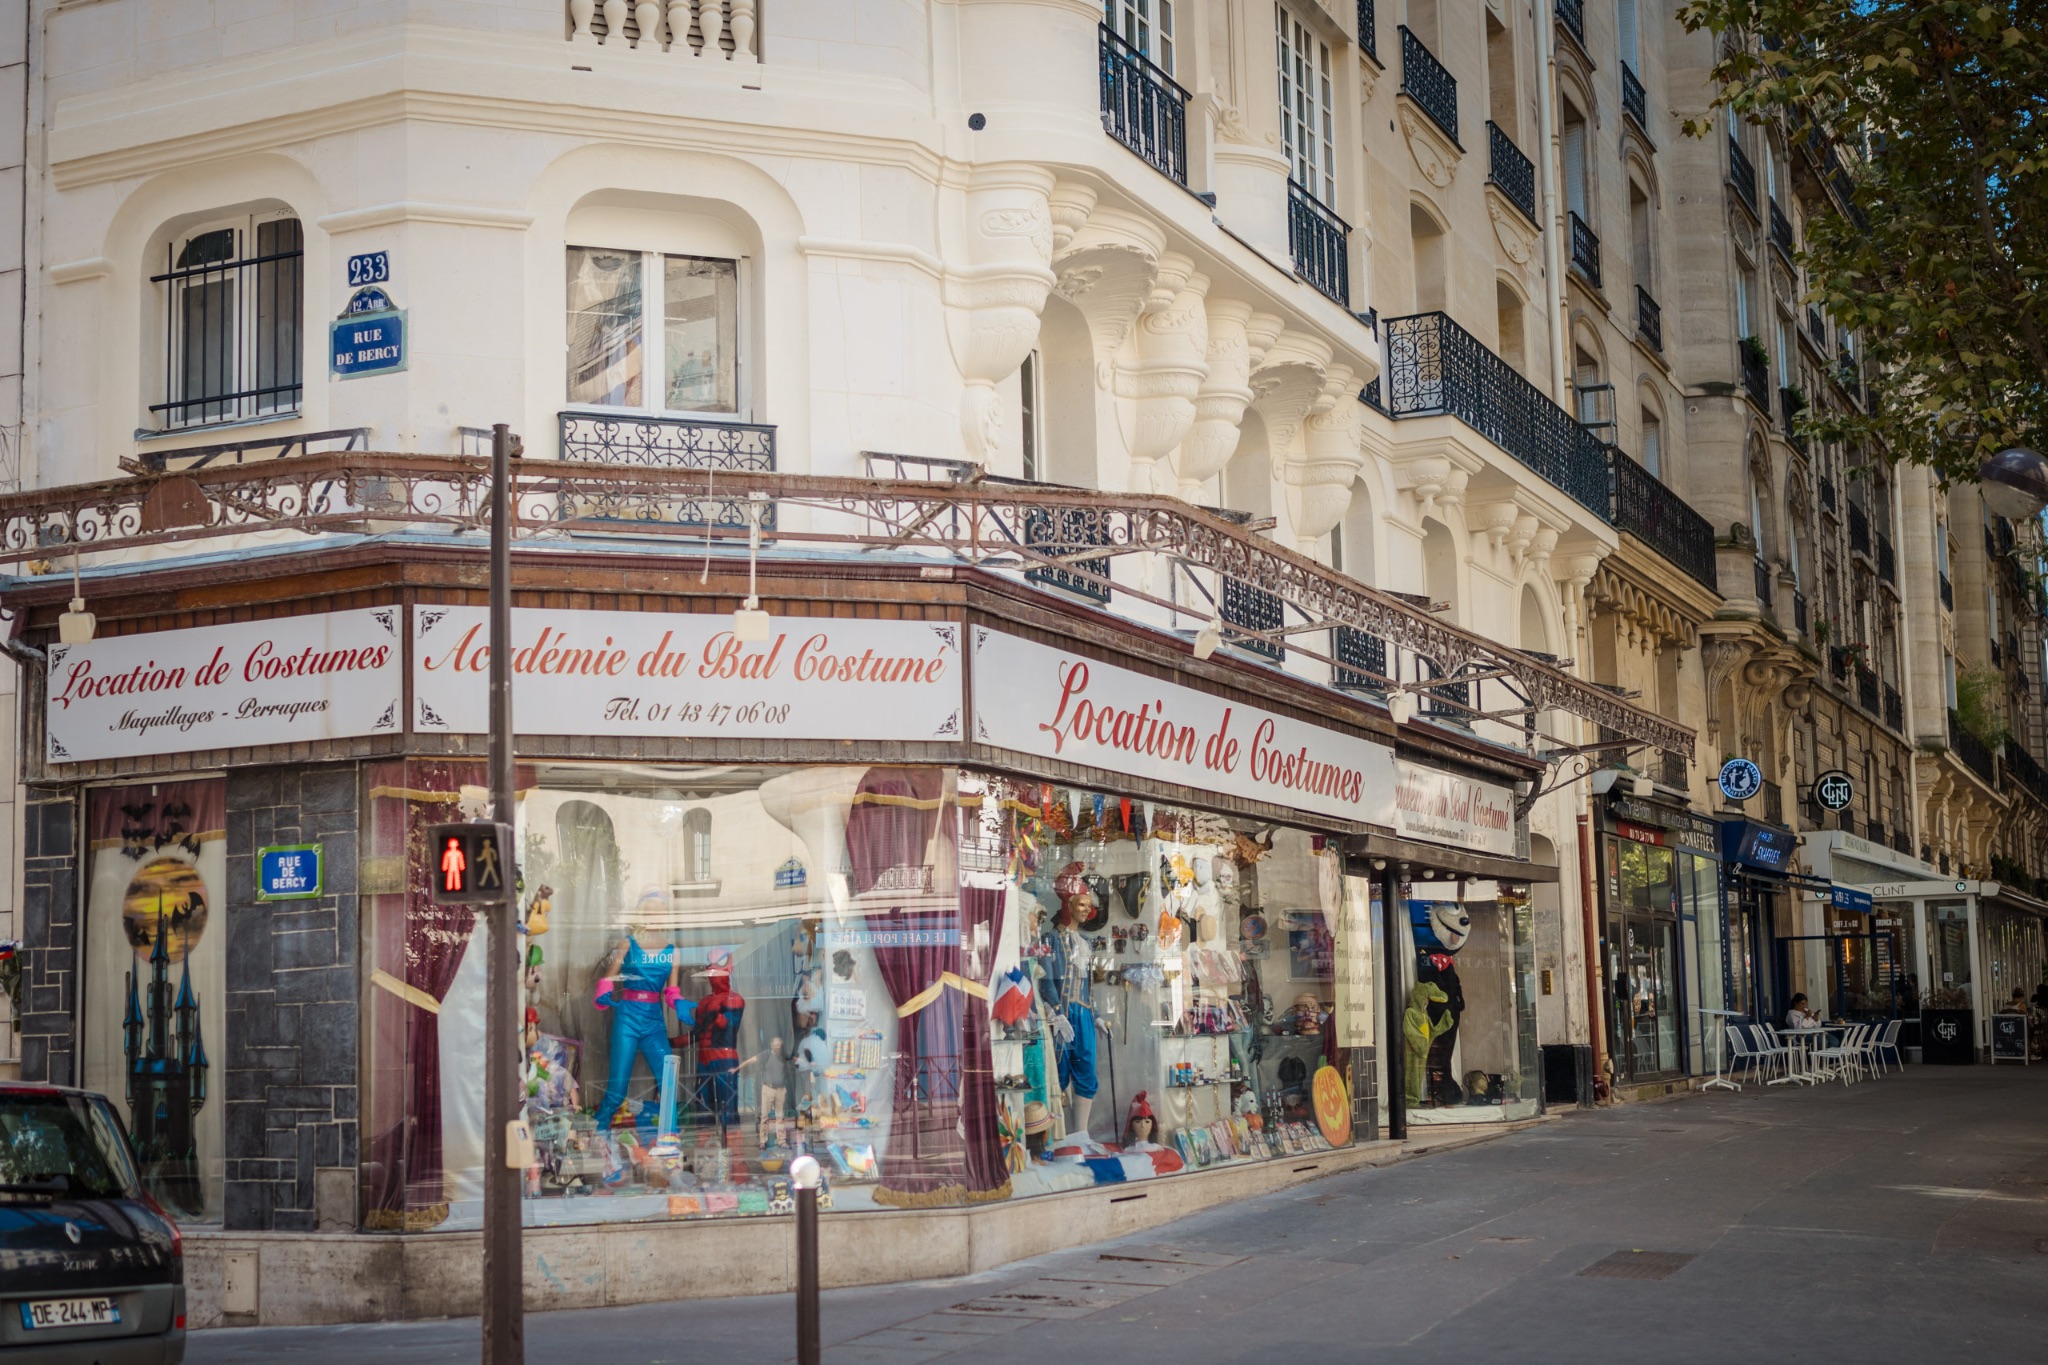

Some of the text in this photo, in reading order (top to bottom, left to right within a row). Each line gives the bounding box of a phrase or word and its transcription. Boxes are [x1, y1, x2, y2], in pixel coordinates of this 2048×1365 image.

[350, 255, 387, 284] 233
[354, 328, 382, 344] RUE
[336, 345, 400, 366] DE BERCY
[423, 622, 951, 684] Acdémie du Bal Costumé
[52, 640, 394, 710] Location de Costumes
[109, 705, 216, 737] Maquillages
[234, 697, 332, 724] Perruques
[604, 697, 791, 726] Tél. 01 43 47 06 08
[1038, 660, 1366, 805] Location de Costumes
[1450, 781, 1472, 824] Bal
[1473, 786, 1511, 832] Costumé
[278, 856, 301, 868] RUE
[282, 867, 295, 878] DE
[272, 877, 307, 889] BERCY
